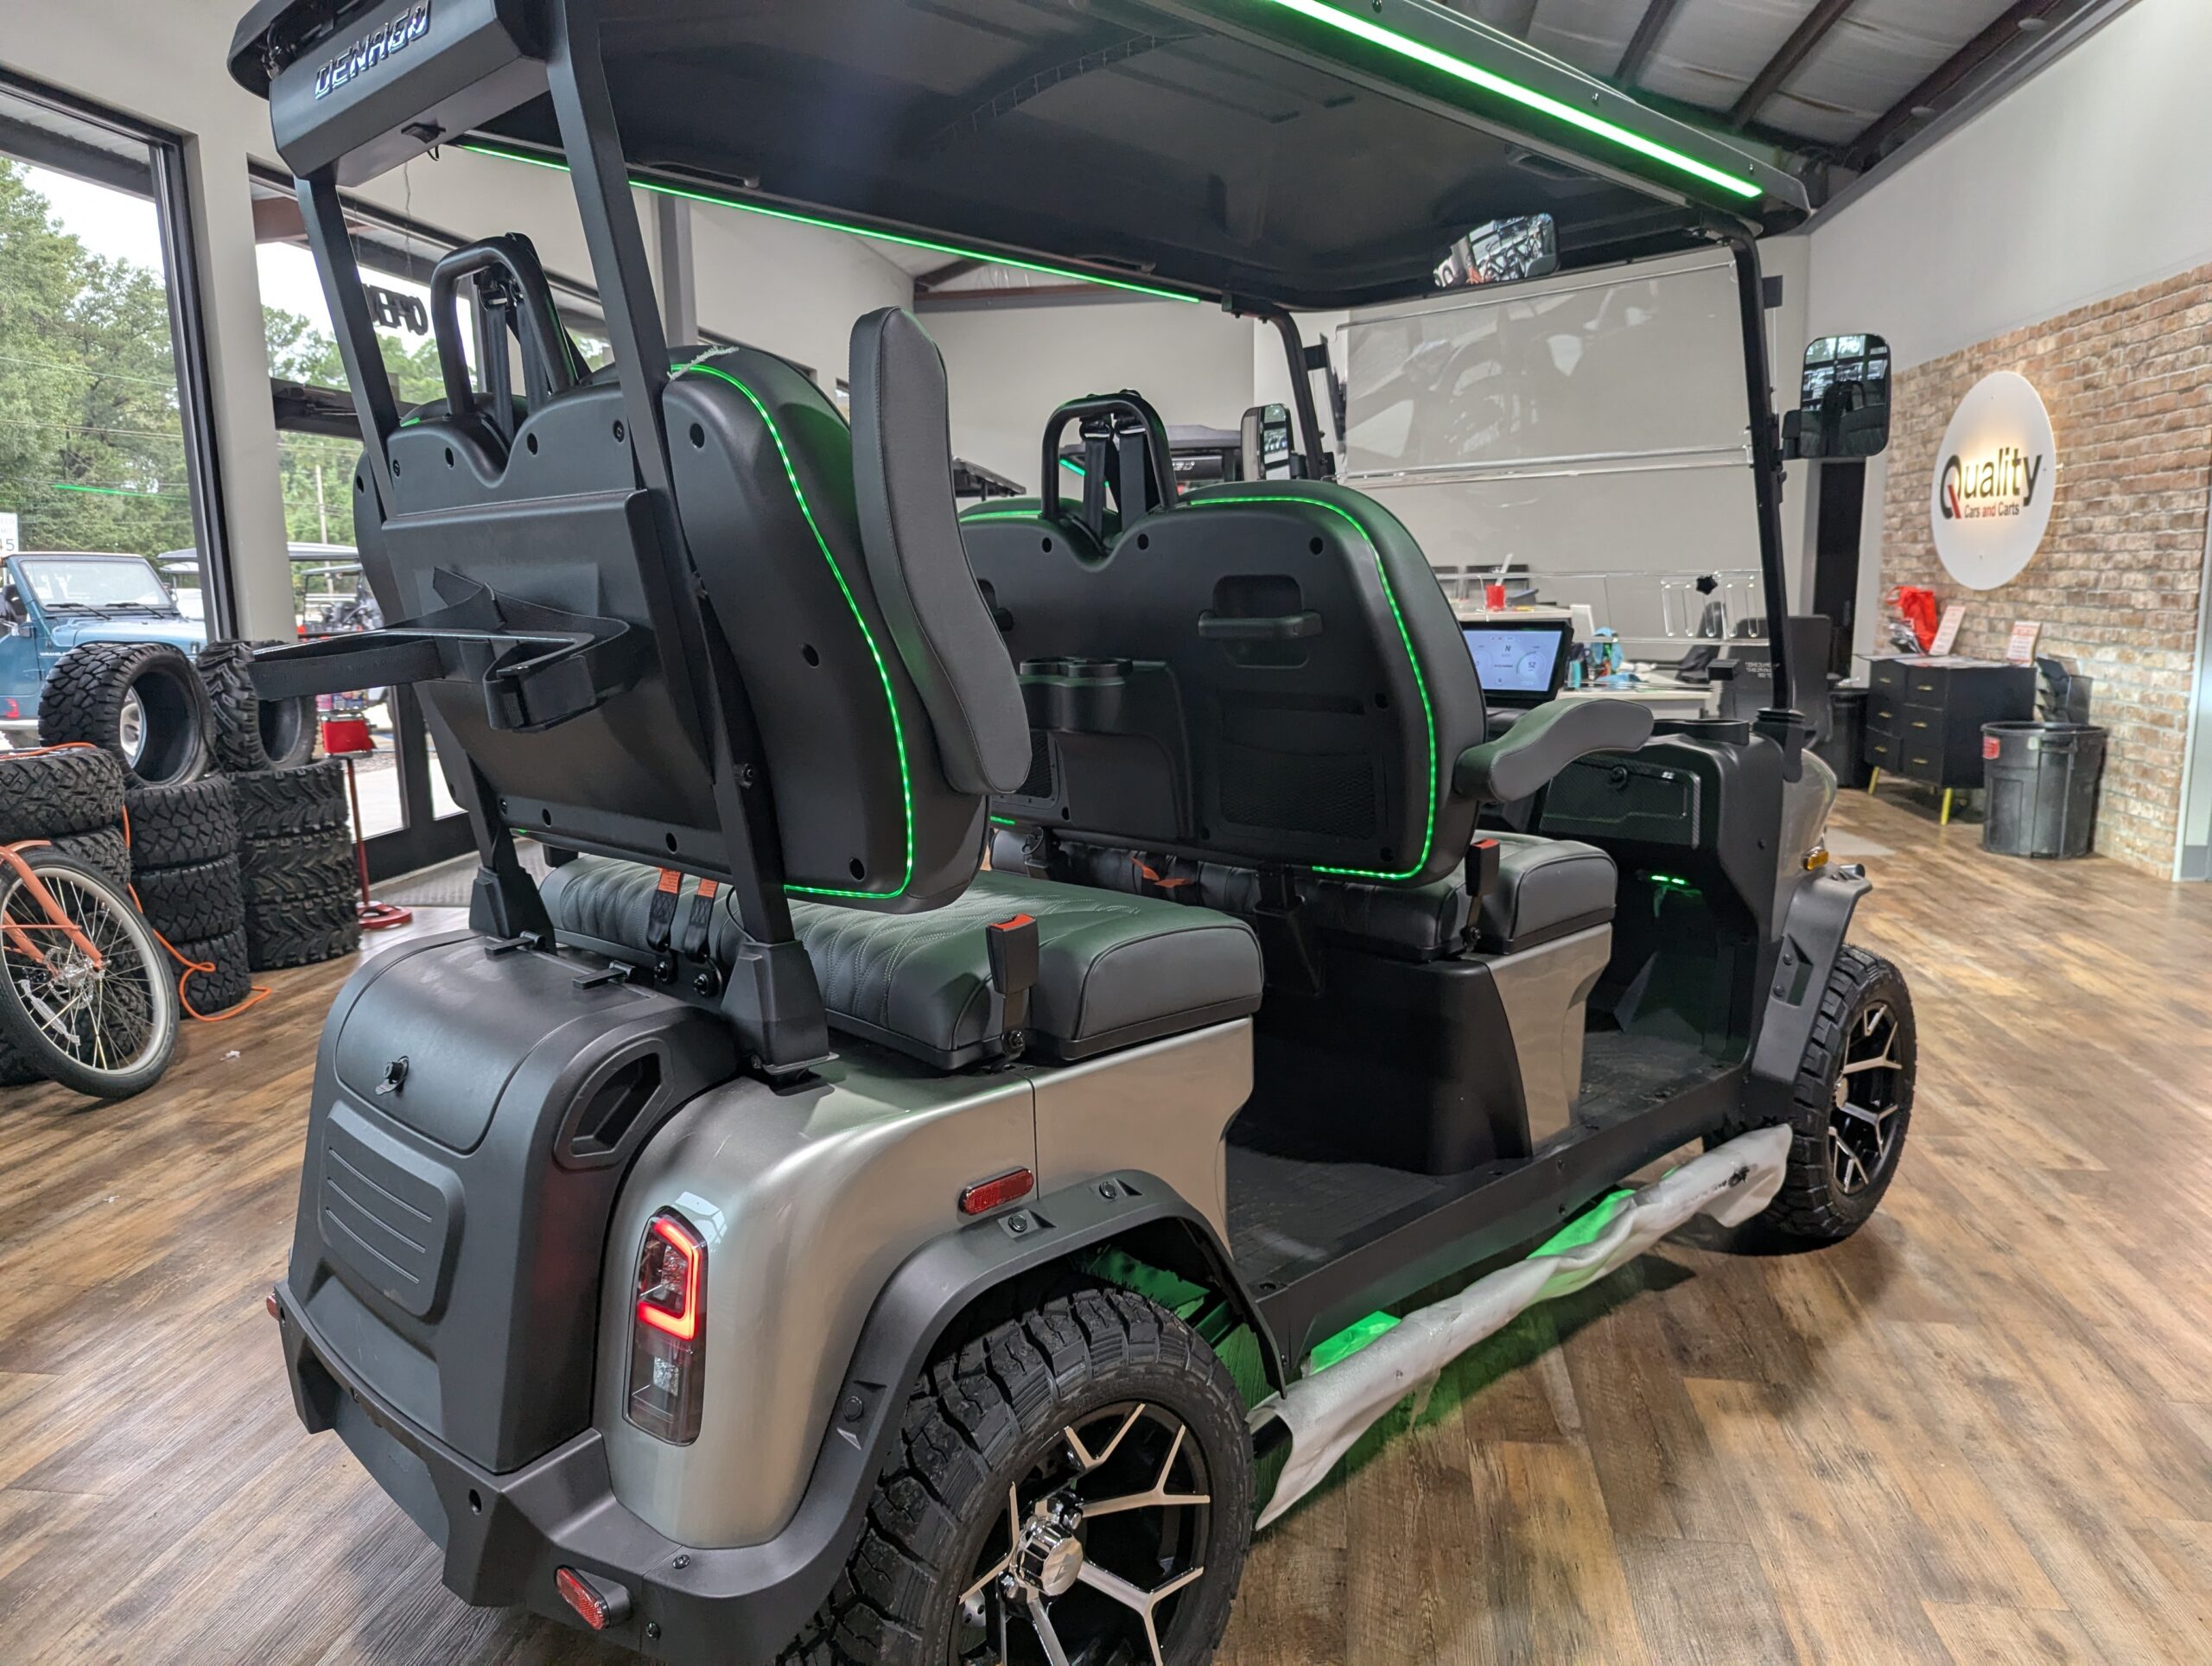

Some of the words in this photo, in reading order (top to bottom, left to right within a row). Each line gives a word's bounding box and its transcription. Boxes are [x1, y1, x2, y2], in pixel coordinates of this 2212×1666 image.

[315, 0, 430, 99] DENAGO
[1940, 447, 2043, 519] Quality
[1964, 505, 1980, 518] Cars
[1982, 504, 1996, 518] and
[1998, 501, 2019, 517] Carts
